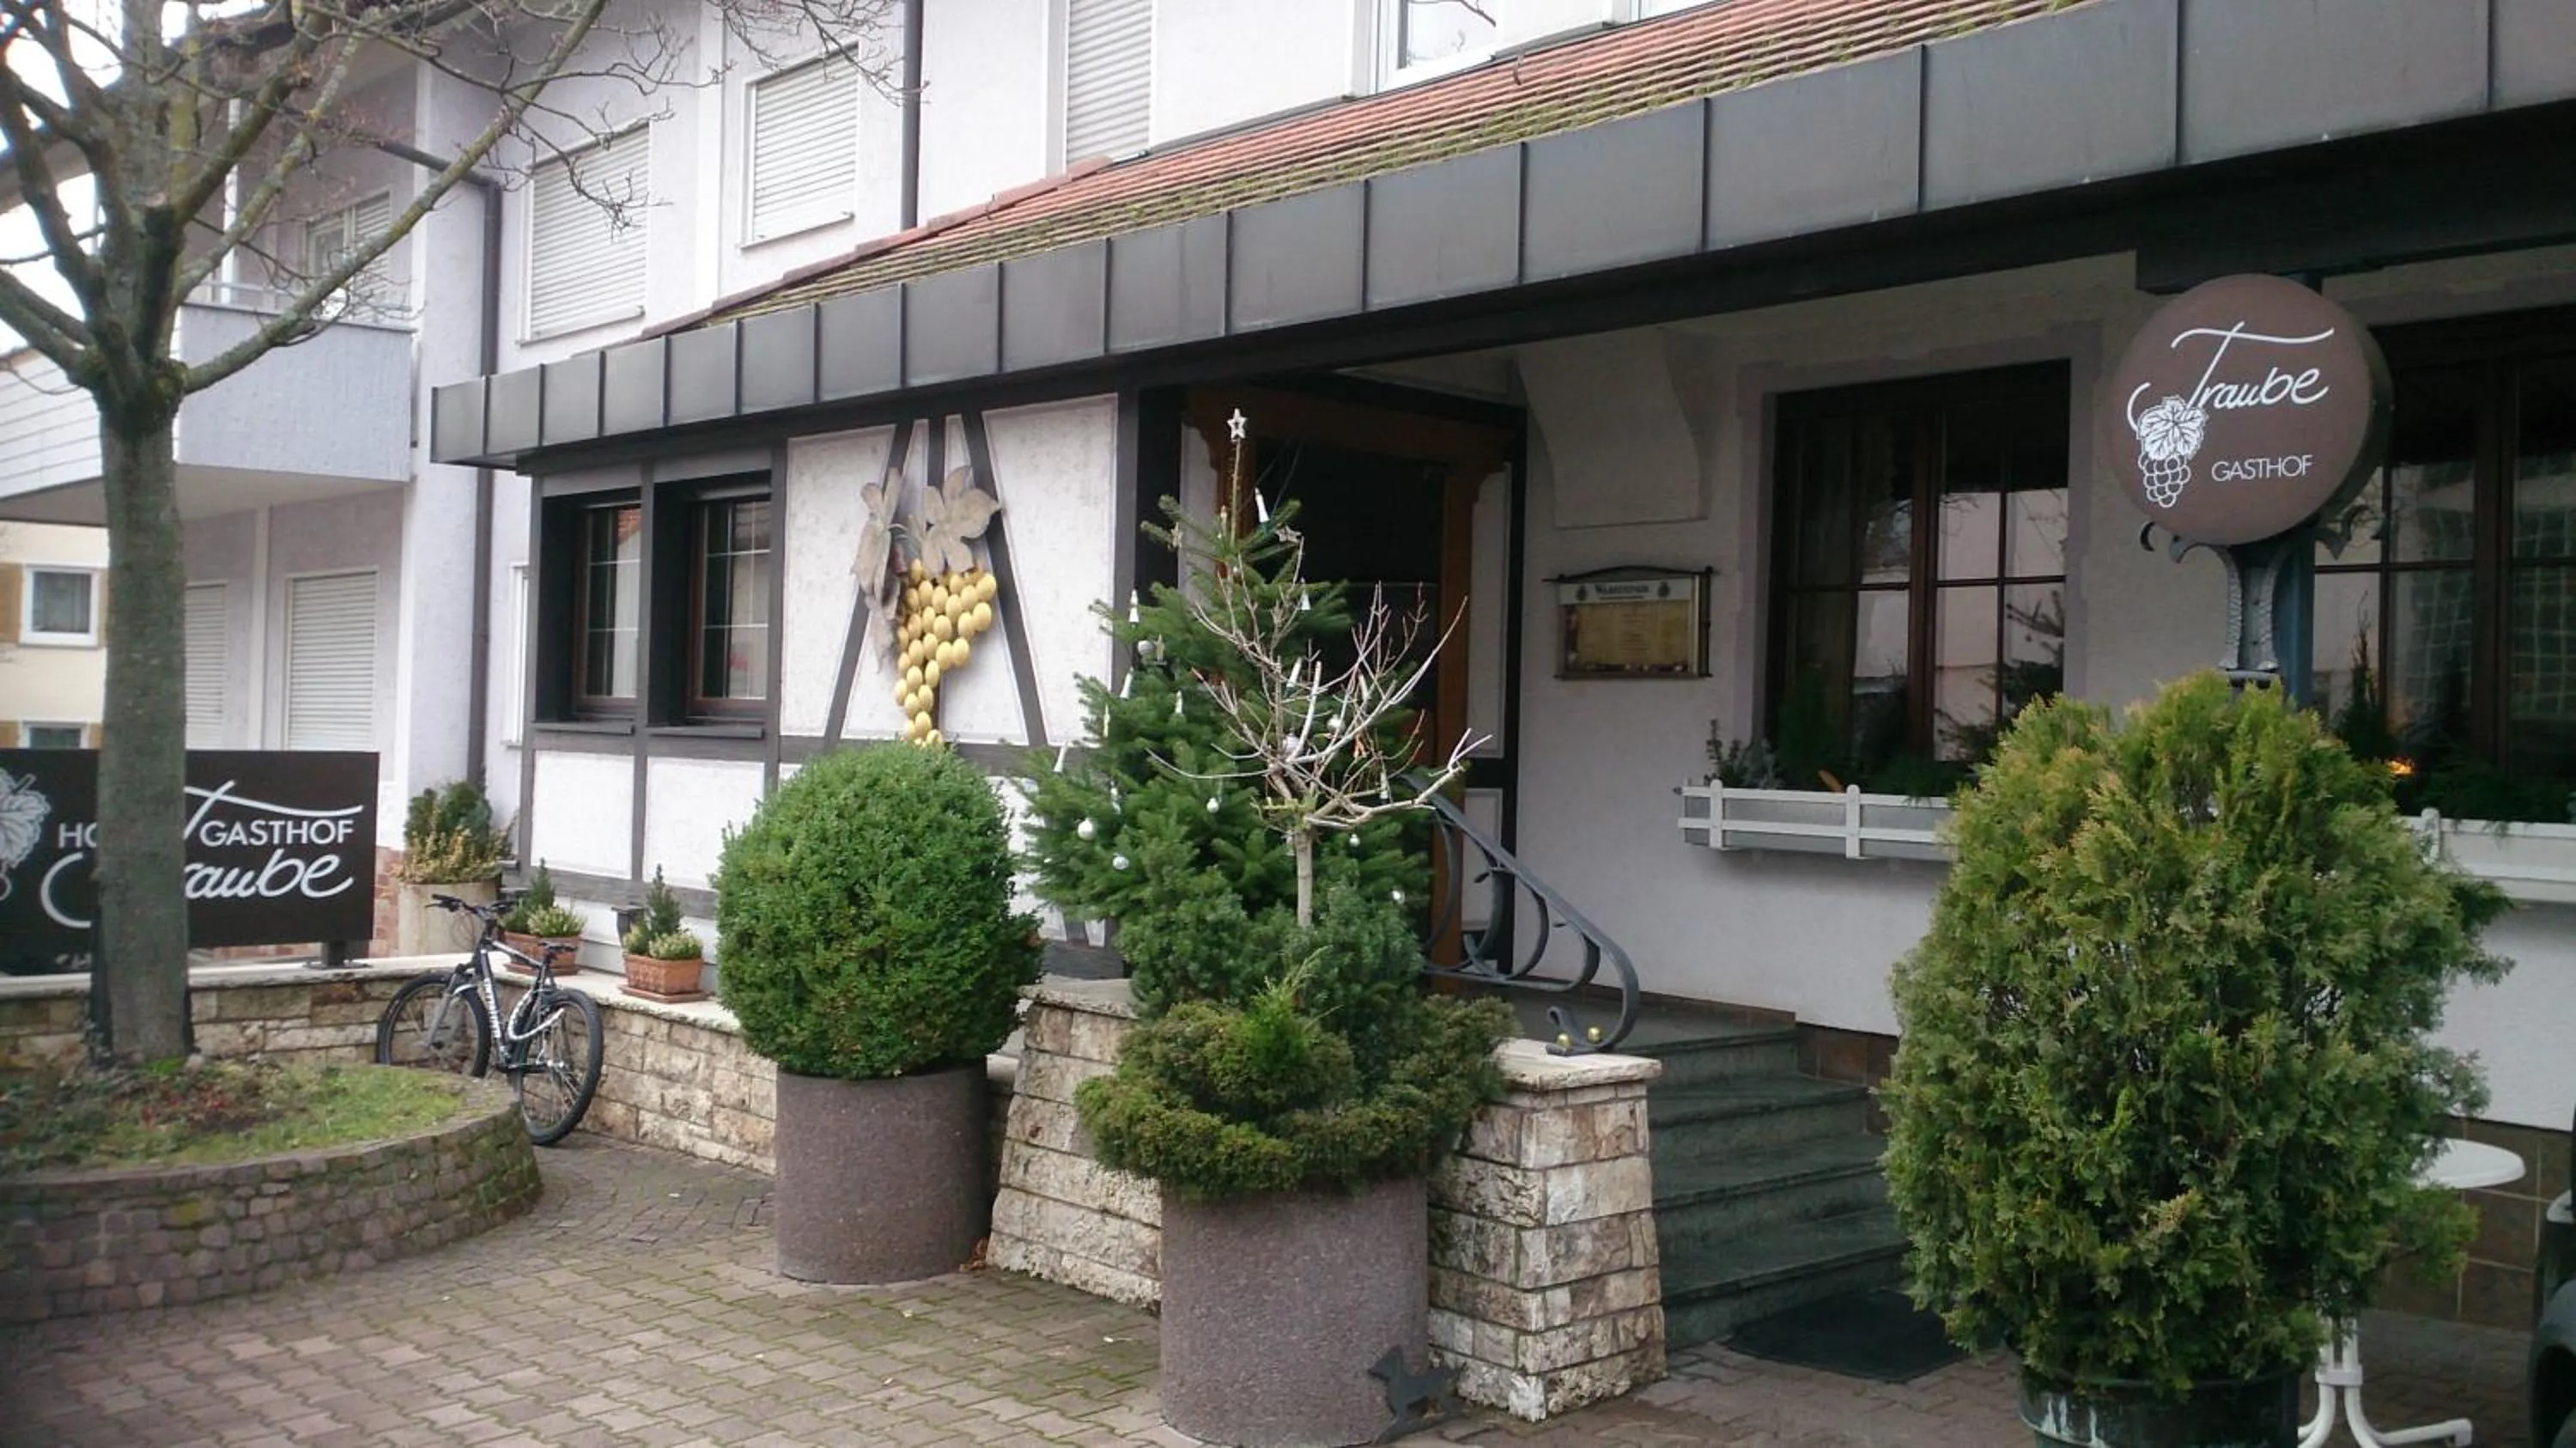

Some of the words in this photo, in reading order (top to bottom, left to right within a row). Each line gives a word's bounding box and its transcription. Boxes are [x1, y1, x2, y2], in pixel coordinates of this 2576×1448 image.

[2127, 320, 2335, 432] Traube
[2211, 454, 2314, 481] GASTHOF
[199, 818, 354, 848] GASTHOF
